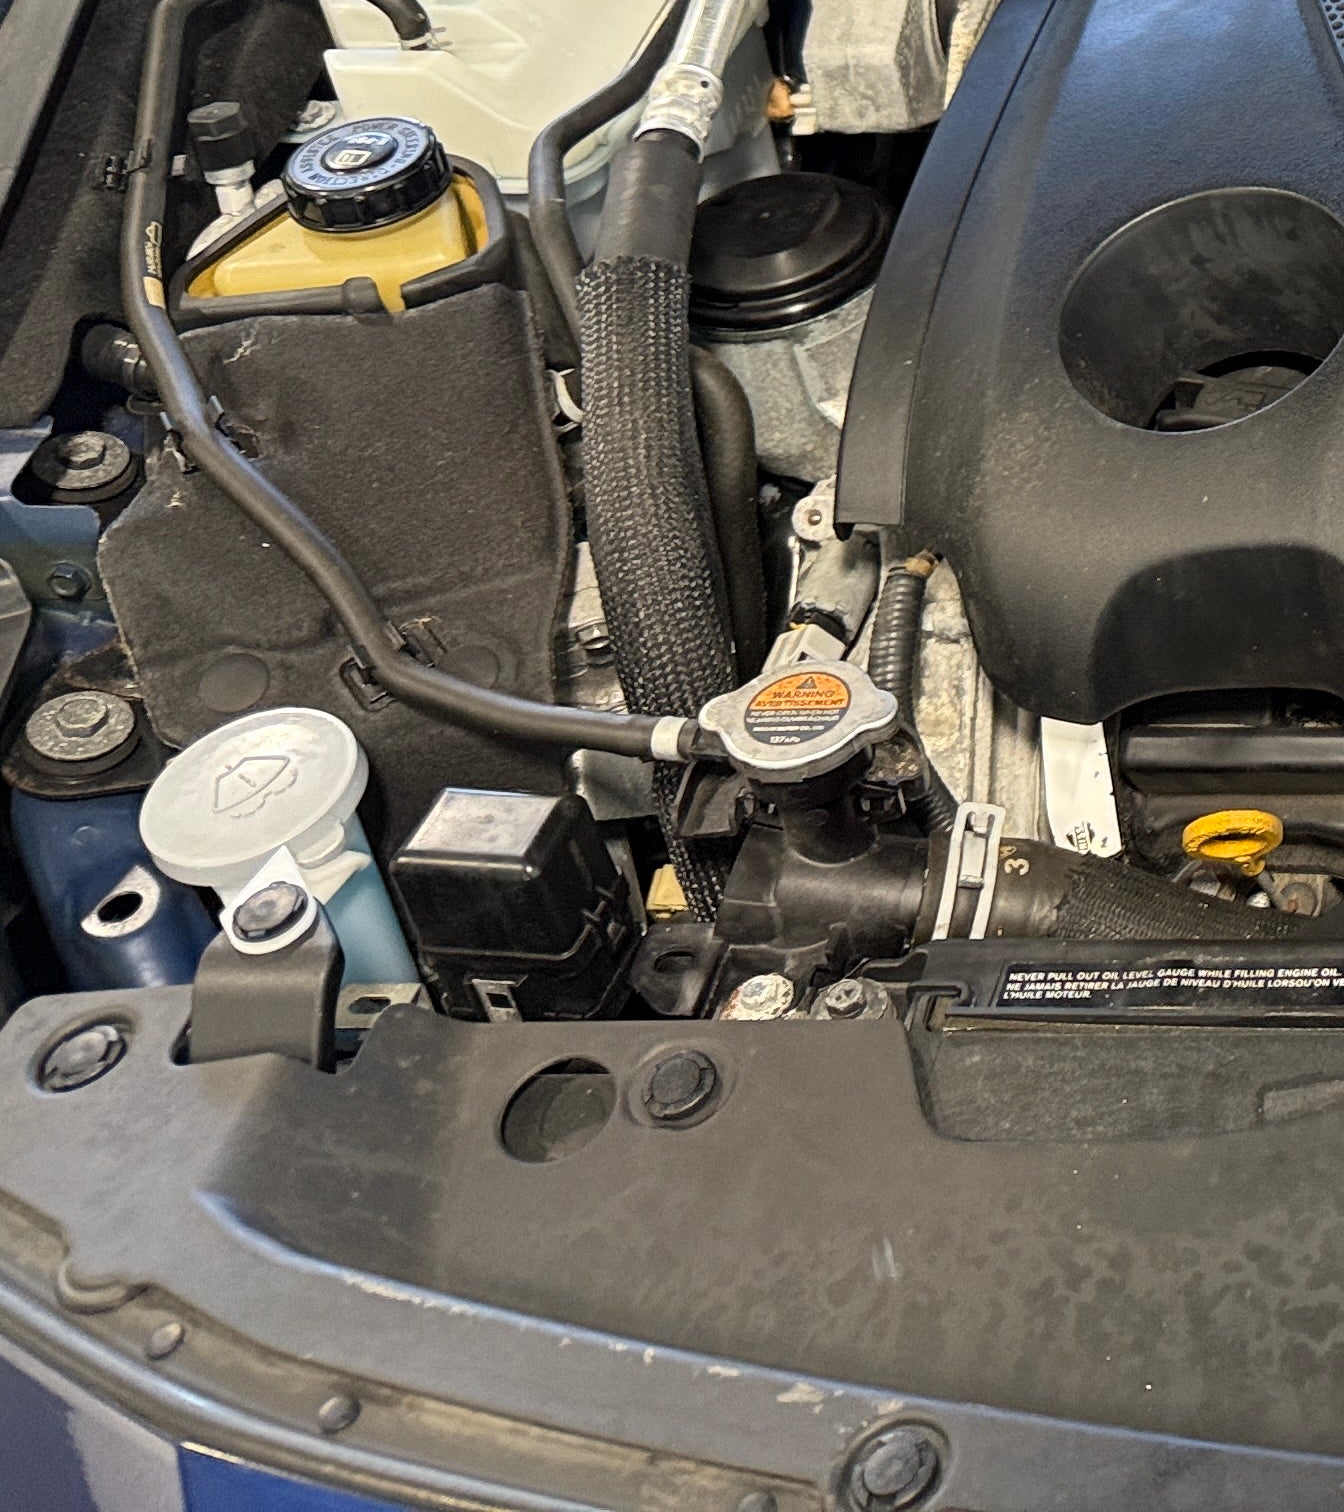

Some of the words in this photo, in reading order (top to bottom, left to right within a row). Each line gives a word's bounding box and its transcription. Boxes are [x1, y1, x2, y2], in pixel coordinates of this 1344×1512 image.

[772, 690, 836, 699] WARNING
[1009, 972, 1045, 981] NEVER
[1047, 972, 1074, 981] PULL
[1076, 971, 1100, 981] OUT
[1101, 971, 1120, 980] OIL
[1122, 970, 1154, 980] LEVEL
[1157, 968, 1196, 977] GAUGE
[1198, 968, 1232, 978] WHILE
[1234, 968, 1275, 978] FILLING
[1277, 968, 1319, 977] ENGINE
[1005, 982, 1021, 991] NE
[1023, 982, 1062, 991] JAMAIS
[1111, 981, 1125, 990] LA
[1127, 979, 1161, 989] JAUGE
[1163, 978, 1178, 987] DE
[1180, 978, 1221, 988] NIVEAU
